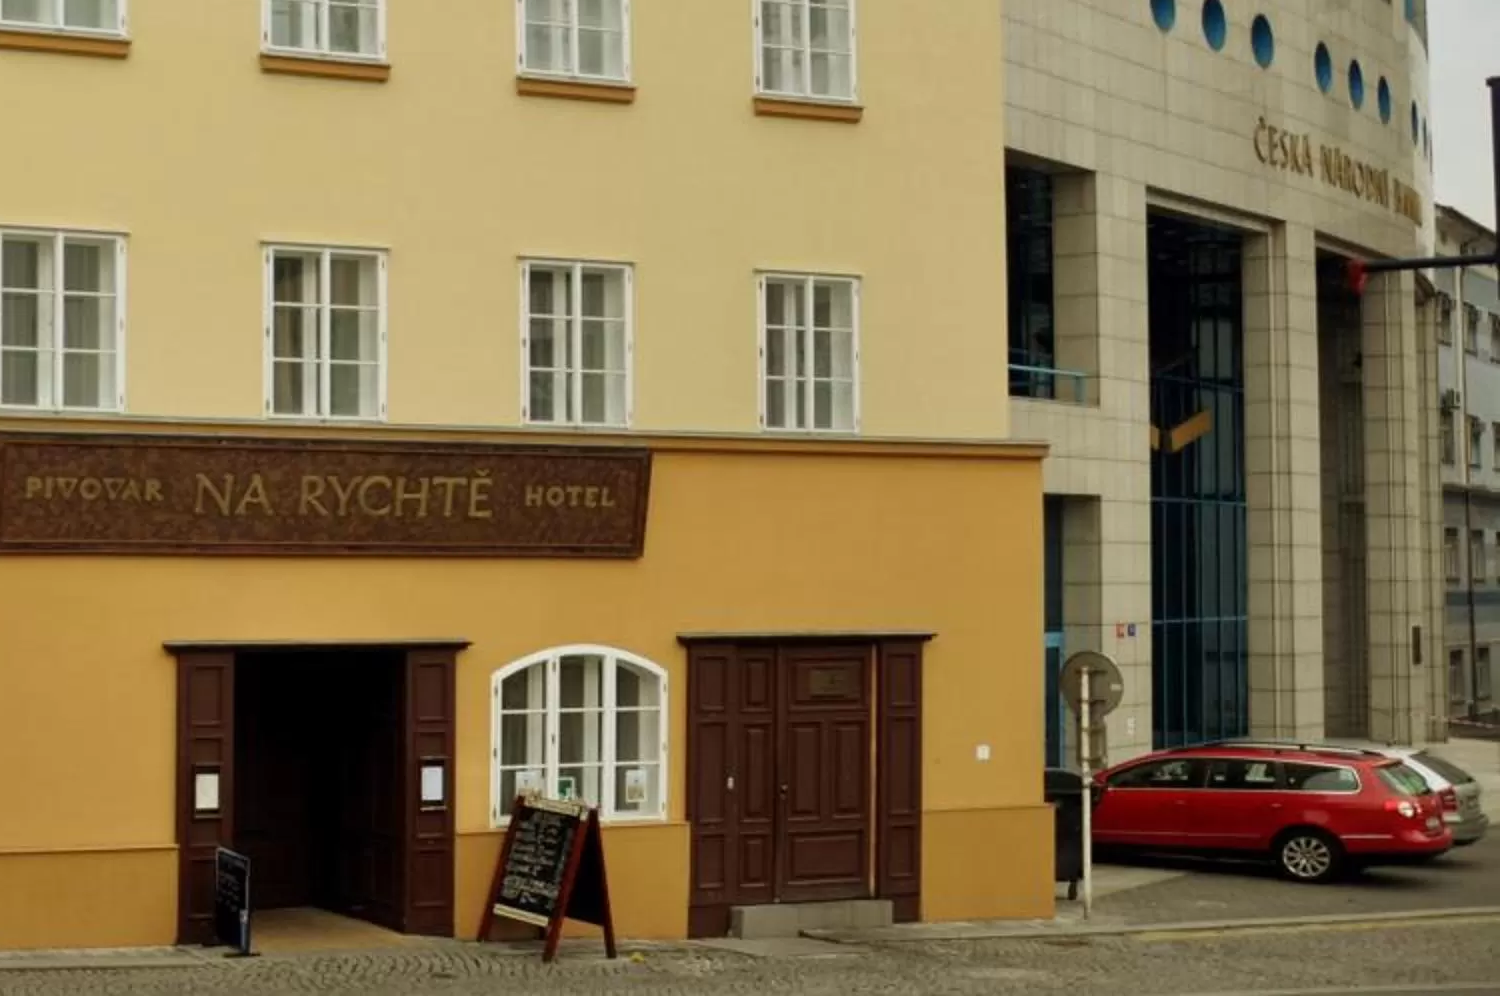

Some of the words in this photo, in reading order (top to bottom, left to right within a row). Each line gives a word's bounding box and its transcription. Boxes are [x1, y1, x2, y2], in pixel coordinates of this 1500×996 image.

[25, 476, 164, 502] PIVOVAR
[194, 472, 274, 516] NA
[299, 468, 493, 518] RYCHTĚ
[525, 485, 616, 508] HOTEL
